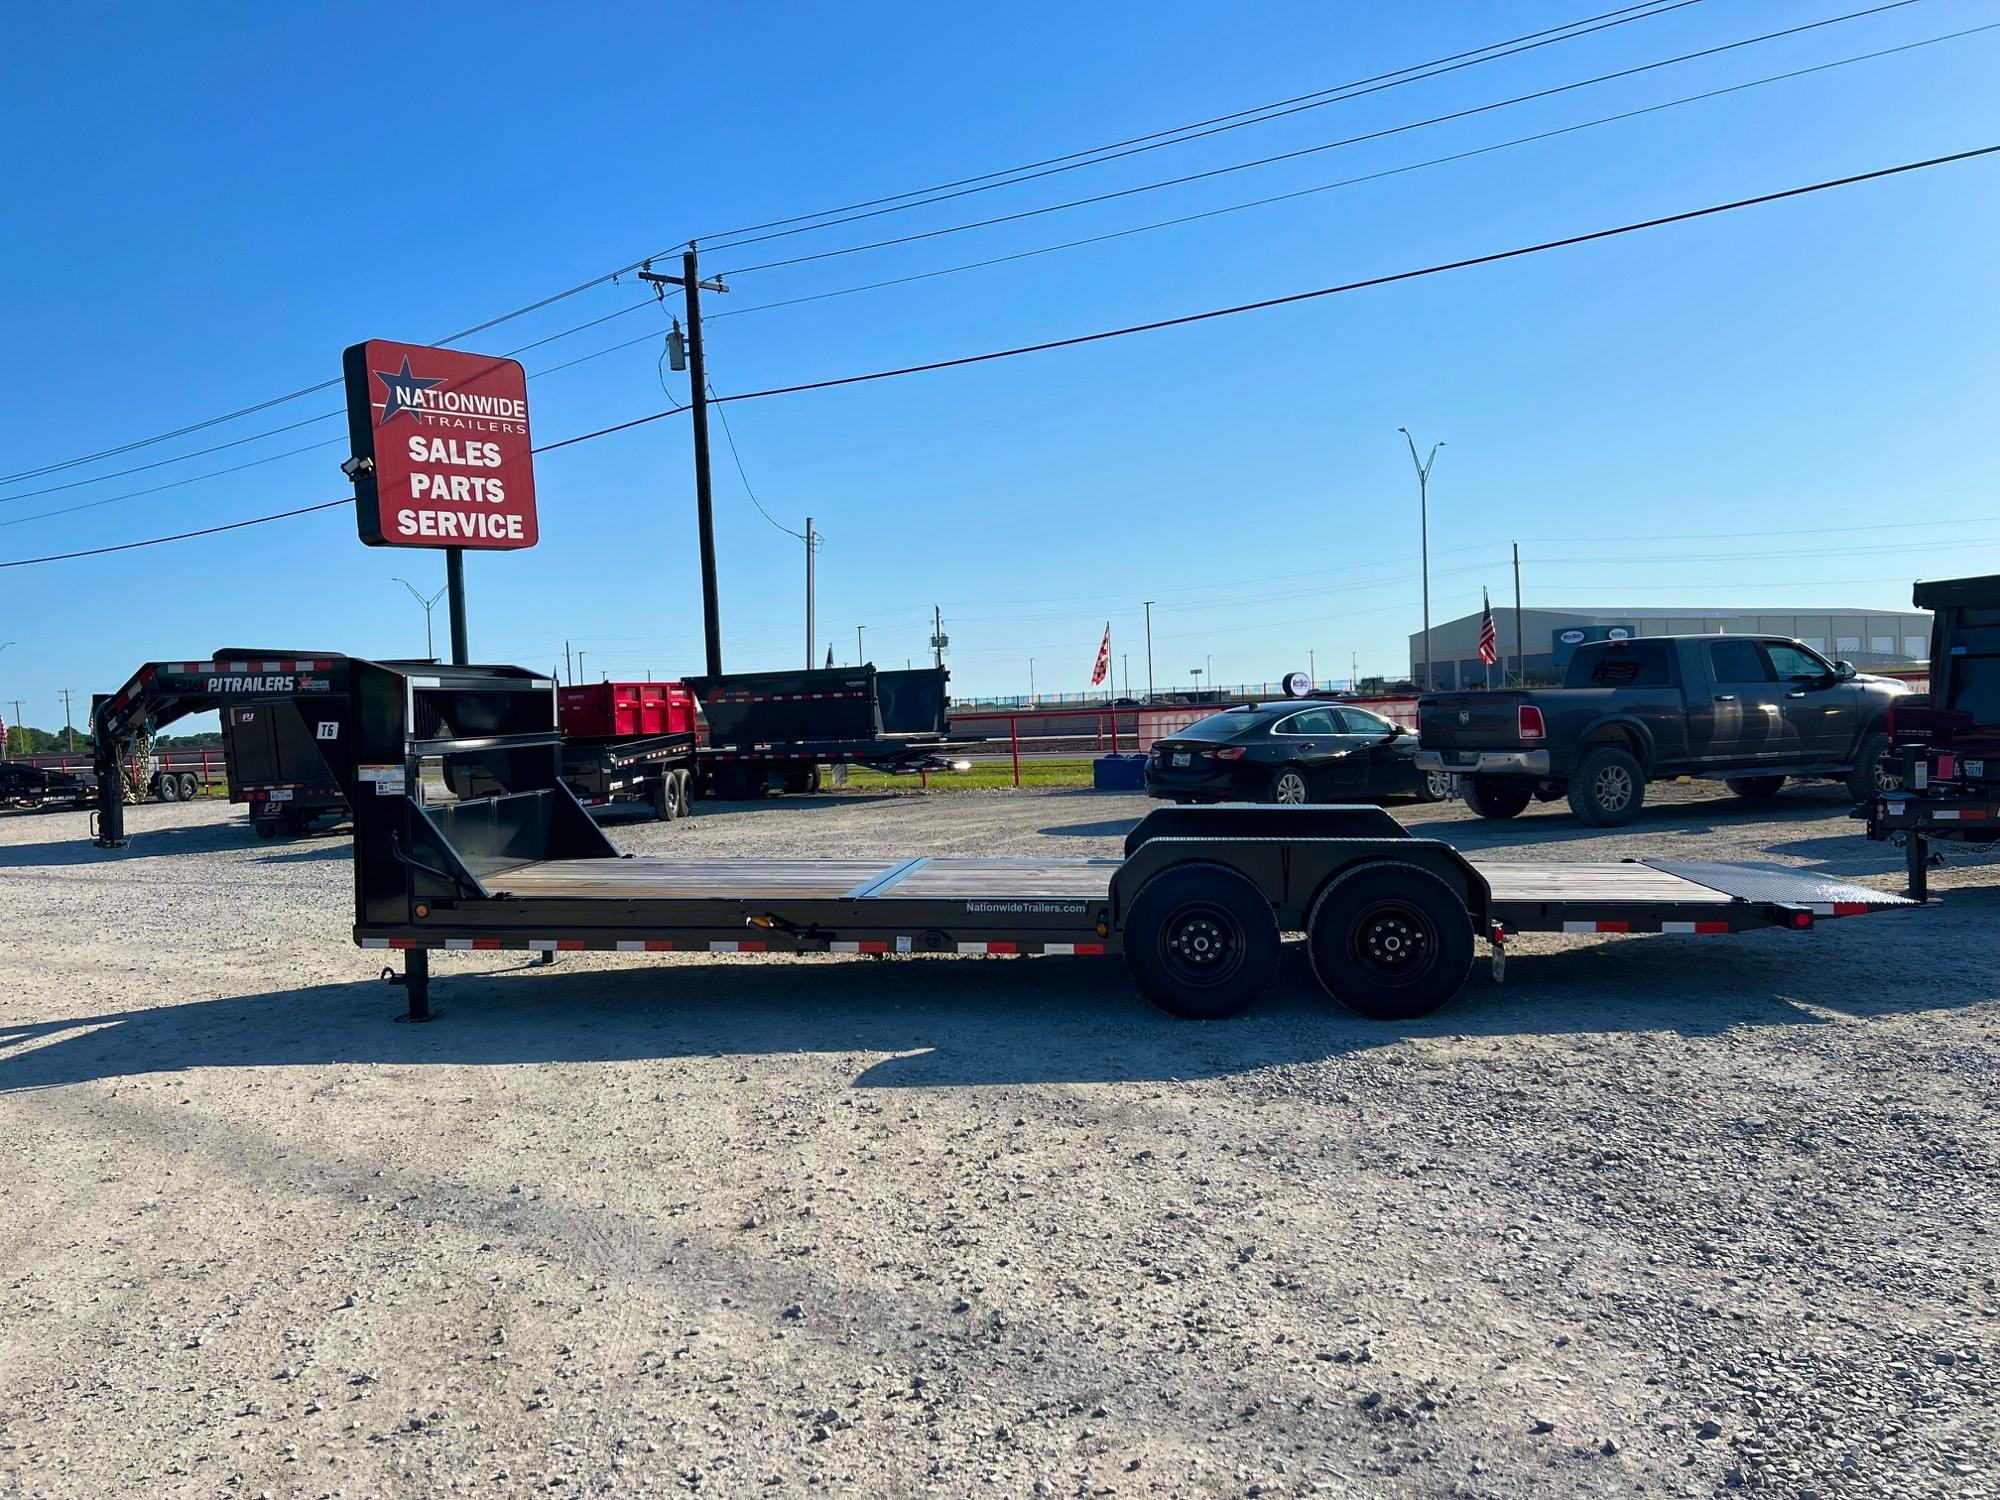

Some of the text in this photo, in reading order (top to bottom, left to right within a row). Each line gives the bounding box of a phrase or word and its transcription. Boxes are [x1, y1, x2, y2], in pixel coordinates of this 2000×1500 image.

[396, 385, 526, 418] NATIONWIDE
[425, 415, 526, 434] TRAILERS
[408, 435, 502, 468] SALES
[410, 472, 505, 503] PARTS
[397, 509, 524, 539] SERVICE
[242, 712, 254, 720] PJ
[321, 724, 334, 736] T6
[966, 902, 1086, 913] NationwideTrailers.com
